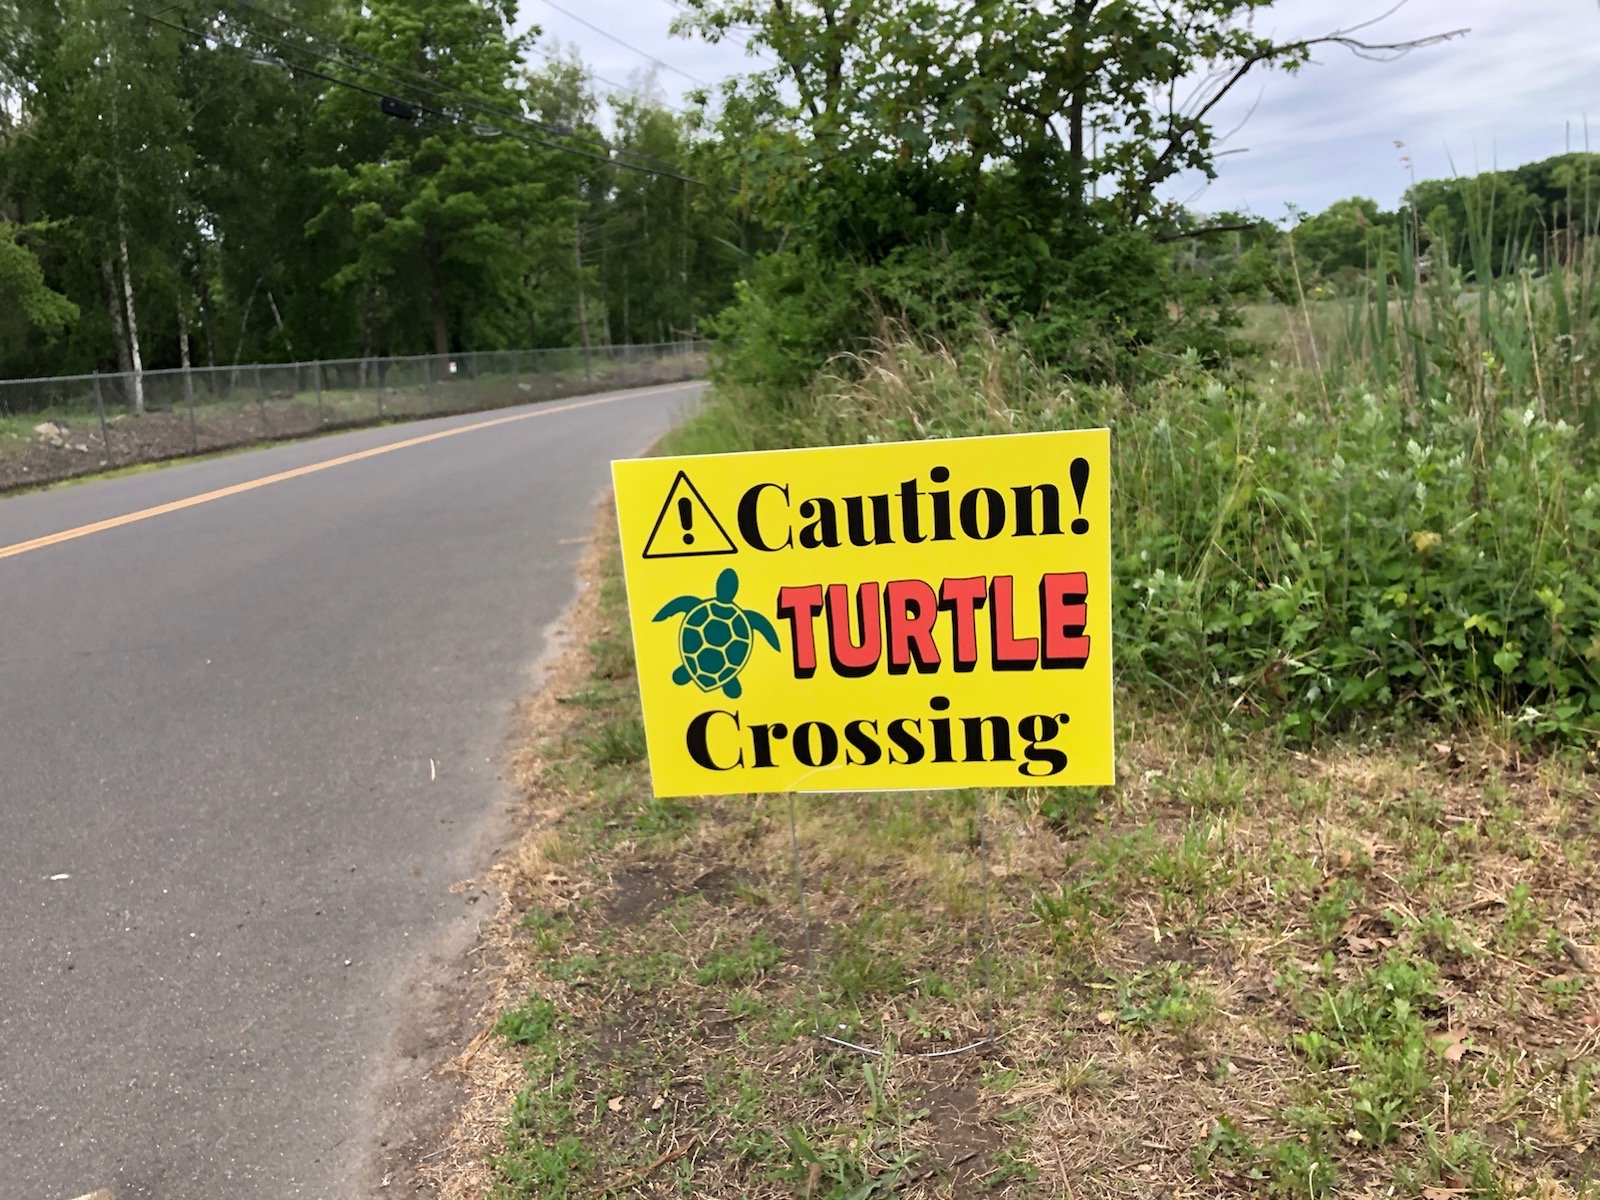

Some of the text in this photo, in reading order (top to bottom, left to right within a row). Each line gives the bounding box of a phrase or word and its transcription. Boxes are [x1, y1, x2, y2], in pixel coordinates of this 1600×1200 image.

[737, 457, 1091, 552] Caution!
[777, 572, 1091, 679] TURTLE
[686, 696, 1070, 777] Crossing
